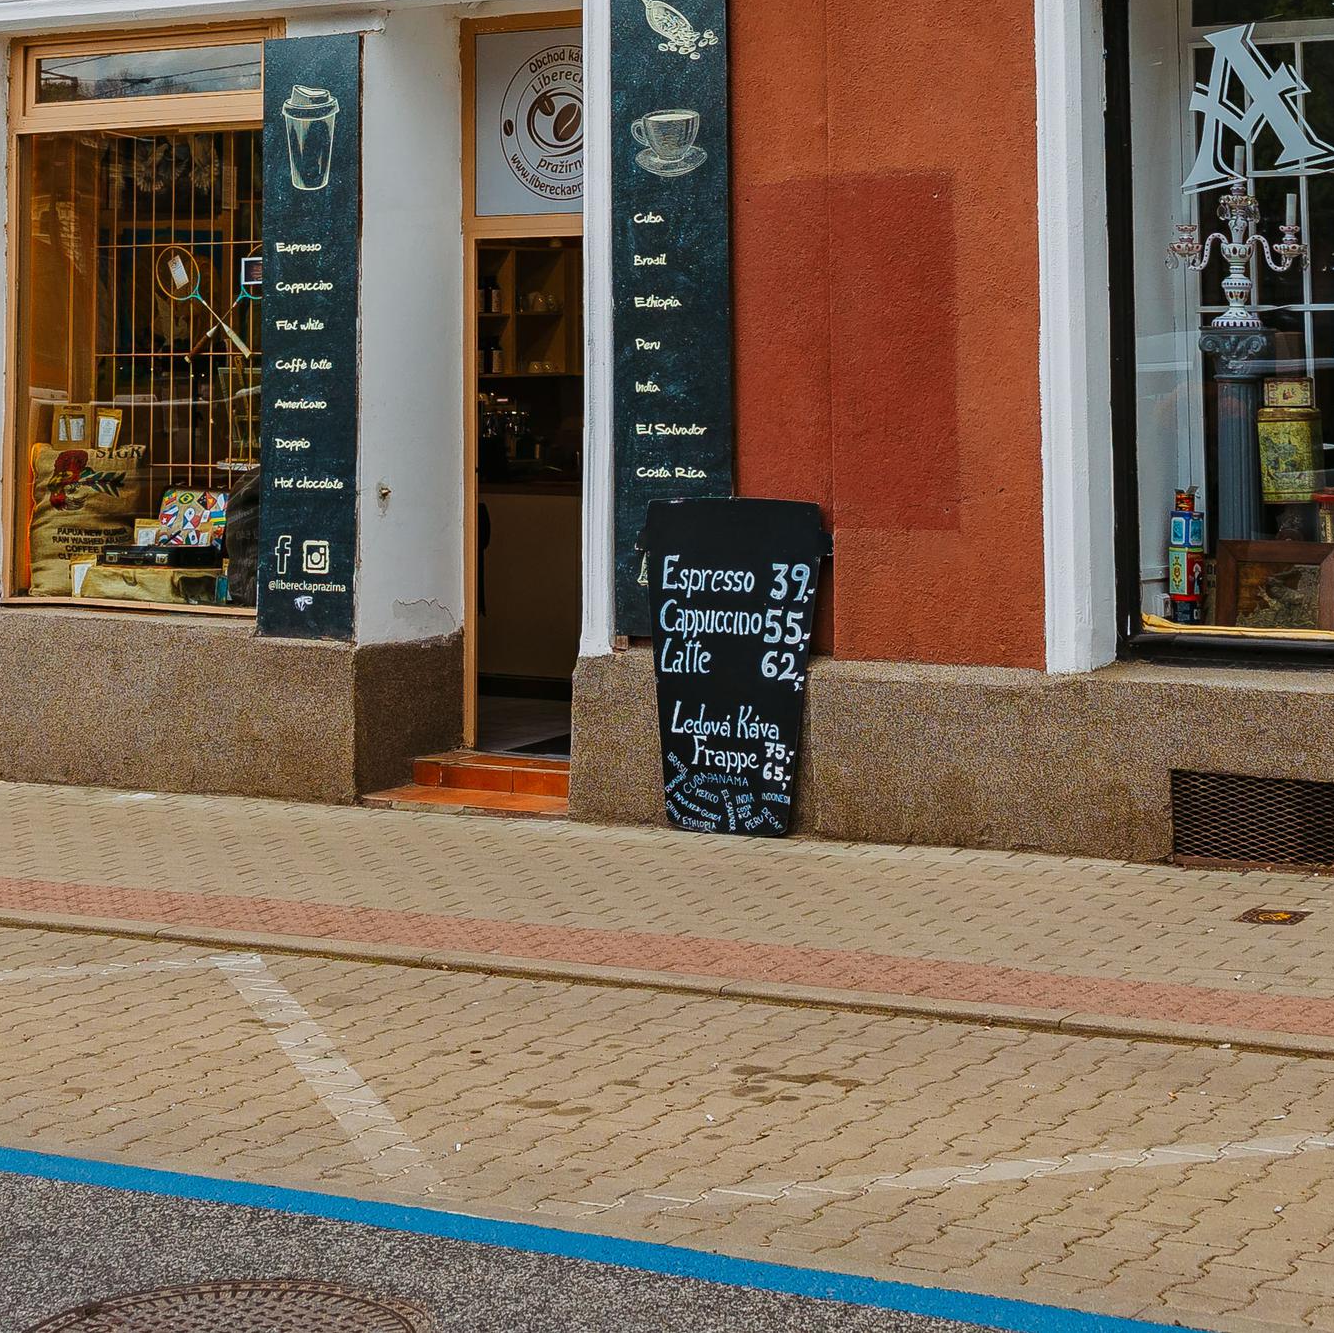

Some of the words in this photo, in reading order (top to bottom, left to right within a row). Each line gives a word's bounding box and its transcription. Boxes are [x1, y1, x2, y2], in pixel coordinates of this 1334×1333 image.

[528, 49, 565, 74] Obchod
[536, 156, 584, 174] pražírn
[510, 153, 584, 197] www.libereckapr
[634, 213, 664, 223] Cuba
[275, 243, 322, 255] Espresso
[634, 253, 666, 266] Brasil
[275, 280, 333, 294] Cappuccino
[634, 296, 681, 310] Ethiopia
[276, 320, 298, 331] Flat
[300, 318, 324, 331] white
[635, 339, 661, 350] Peru
[310, 358, 333, 370] latte
[635, 381, 661, 393] India
[274, 398, 327, 410] Americano
[636, 424, 651, 435] El
[656, 423, 708, 436] Salvador
[275, 438, 310, 451] Doppio
[636, 467, 671, 479] Costa
[674, 467, 707, 479] Rica
[274, 477, 294, 488] Hot
[296, 476, 344, 489] chocolate
[57, 528, 83, 536] PAPUA
[65, 545, 100, 554] COFFEE
[662, 554, 755, 599] Espresso
[660, 599, 762, 640] Cappuccino
[660, 638, 711, 674] Latte
[671, 700, 731, 738] Ledová
[737, 705, 779, 740] Káva
[691, 735, 759, 773] Frappe
[683, 772, 707, 794] CUBA
[707, 772, 749, 787] PANAMA
[695, 787, 719, 804] MEXICO
[735, 792, 755, 805] INDIA
[682, 815, 717, 830] ETHIOPIA
[744, 815, 764, 830] PERU
